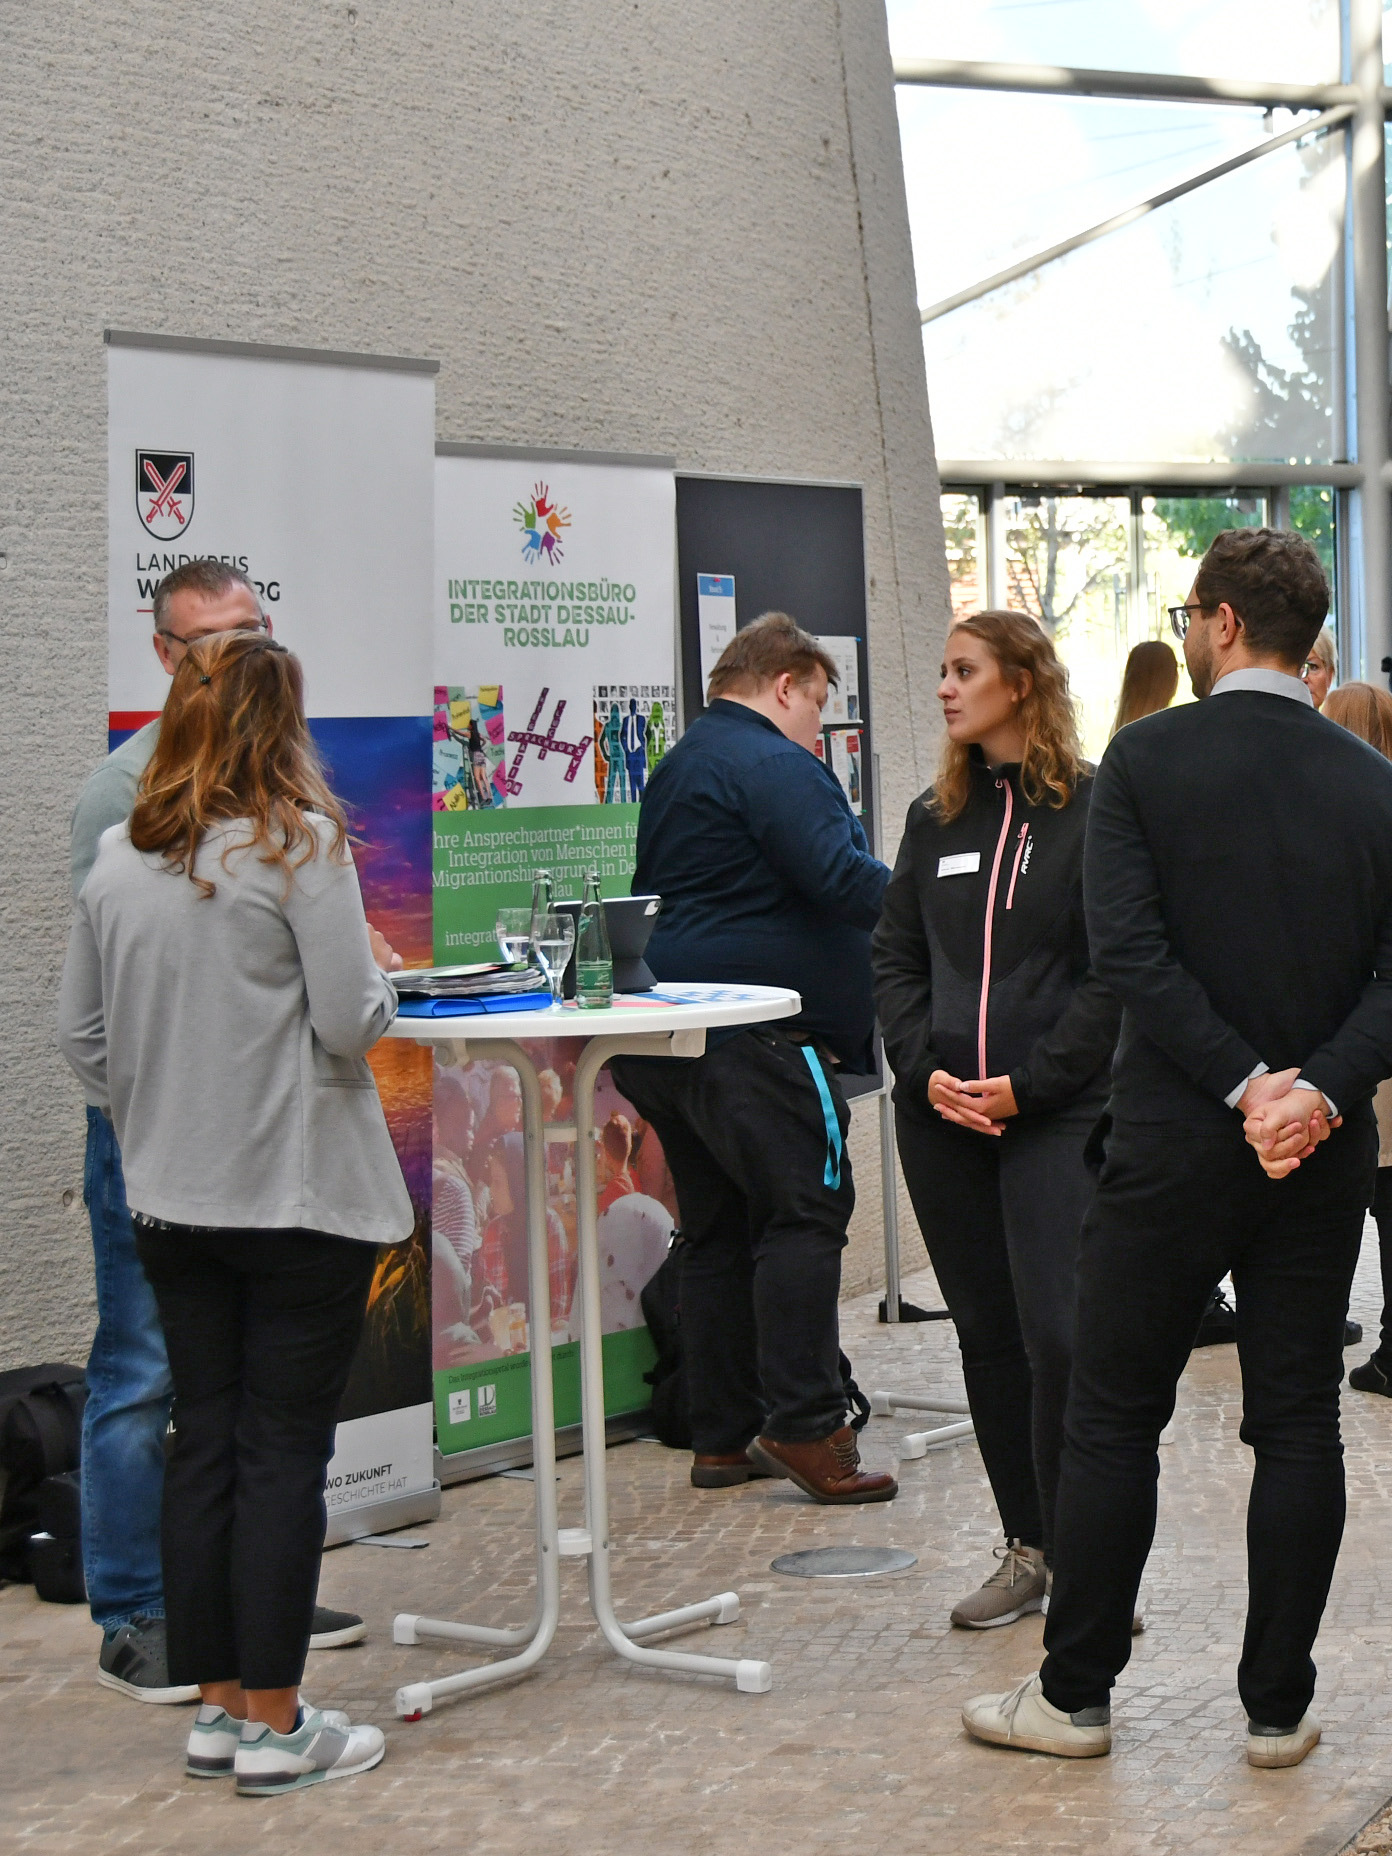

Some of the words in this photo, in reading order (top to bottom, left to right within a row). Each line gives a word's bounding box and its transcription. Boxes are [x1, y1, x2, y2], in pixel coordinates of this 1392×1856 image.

[448, 577, 636, 603] INTEGRATIONSBÜRO
[450, 604, 489, 624] DER
[494, 604, 552, 625] STADT
[557, 604, 636, 626] DESSAU-
[503, 627, 590, 648] ROSSLAU
[433, 830, 460, 849] hre
[625, 822, 638, 838] fü
[449, 847, 528, 869] Integration
[531, 847, 554, 862] von
[556, 841, 627, 860] Menschen
[602, 861, 616, 876] in
[345, 1463, 393, 1486] ZUKUNFT
[388, 1476, 408, 1492] HAT
